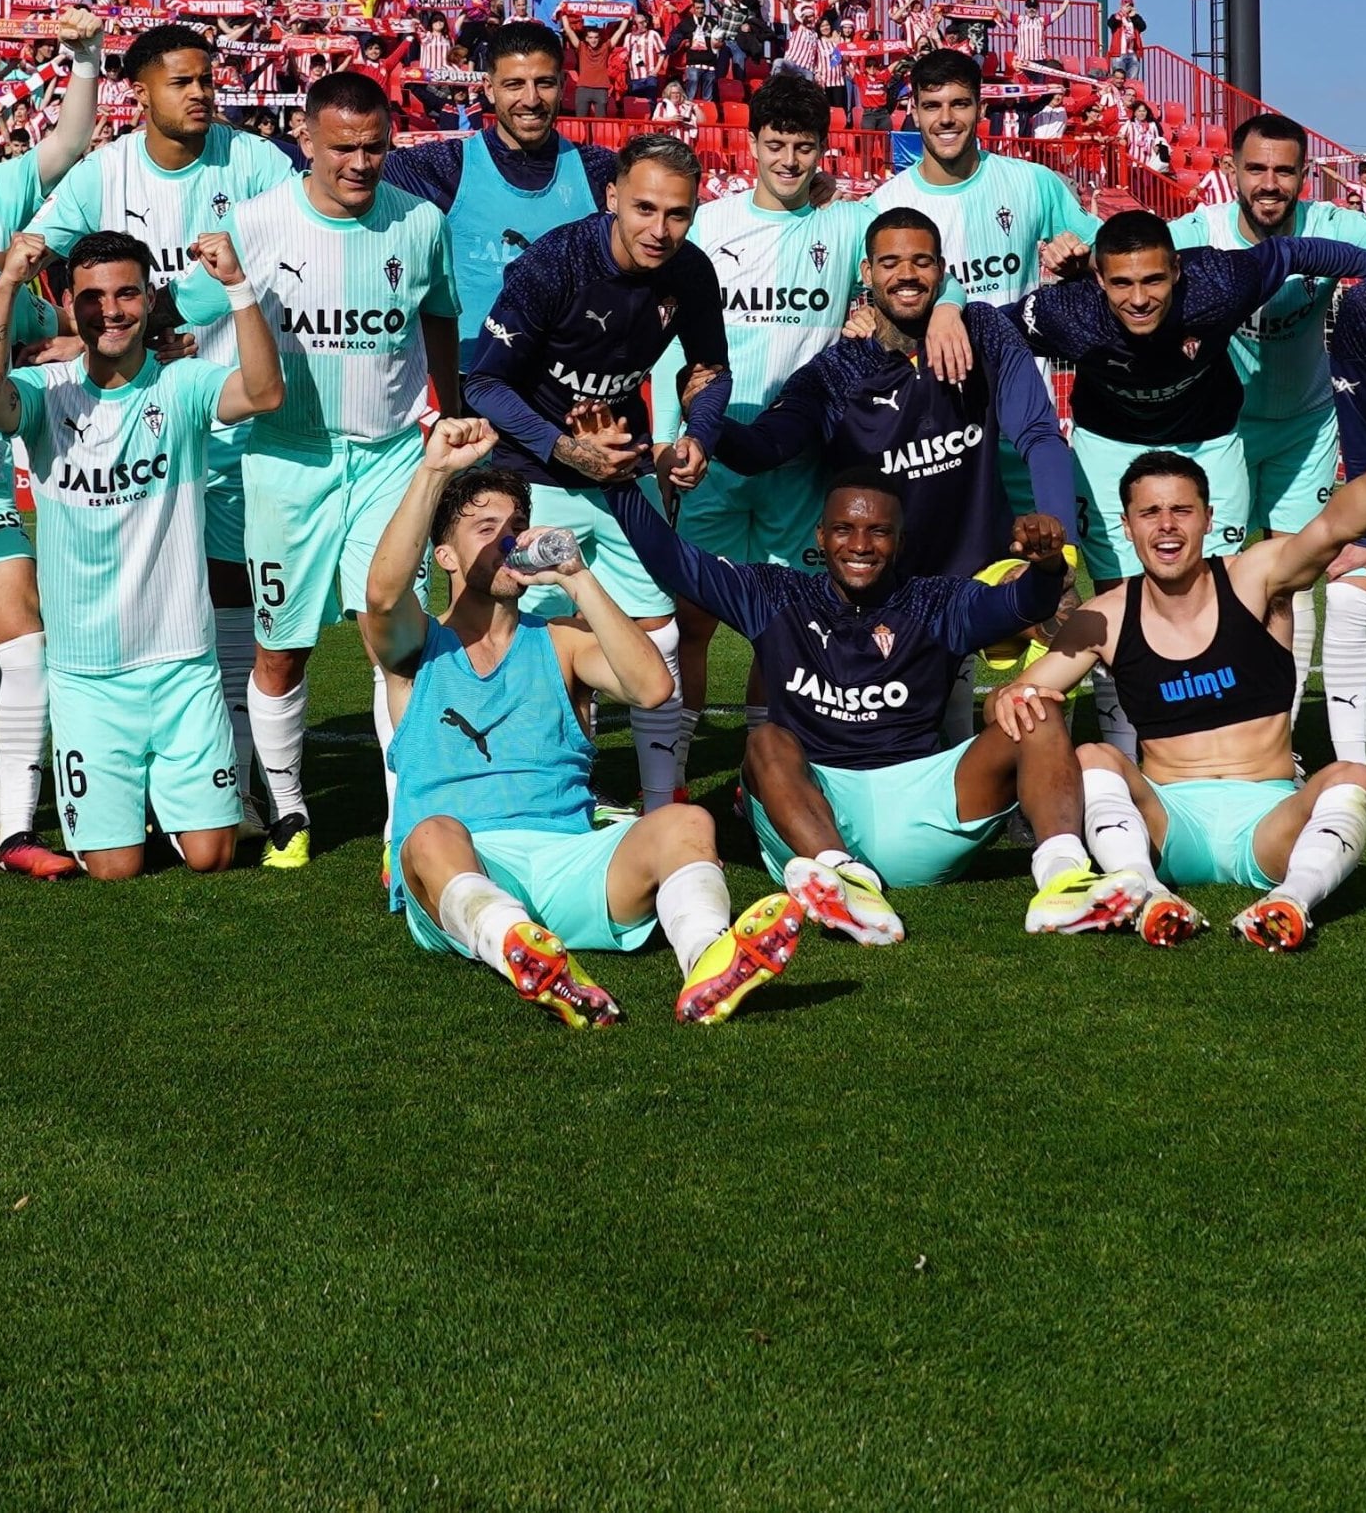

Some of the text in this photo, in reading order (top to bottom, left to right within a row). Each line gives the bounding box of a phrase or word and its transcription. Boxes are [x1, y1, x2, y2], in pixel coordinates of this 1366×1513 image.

[121, 6, 151, 17] GIJON
[187, 0, 245, 14] SPORTING
[434, 70, 484, 84] SPORTIN
[721, 288, 830, 313] JALISCO
[280, 307, 406, 336] JALISCO
[745, 314, 802, 325] ES MÉXICO
[311, 337, 377, 350] ES MÉXICO
[880, 423, 984, 476] JALISCO
[57, 452, 169, 493] JALISCO
[907, 457, 963, 480] ES MÉXICO
[87, 489, 148, 508] ES MÉXICO
[785, 666, 910, 711] JALISCO
[814, 703, 879, 723] ES MÉXICO
[54, 748, 87, 799] 16
